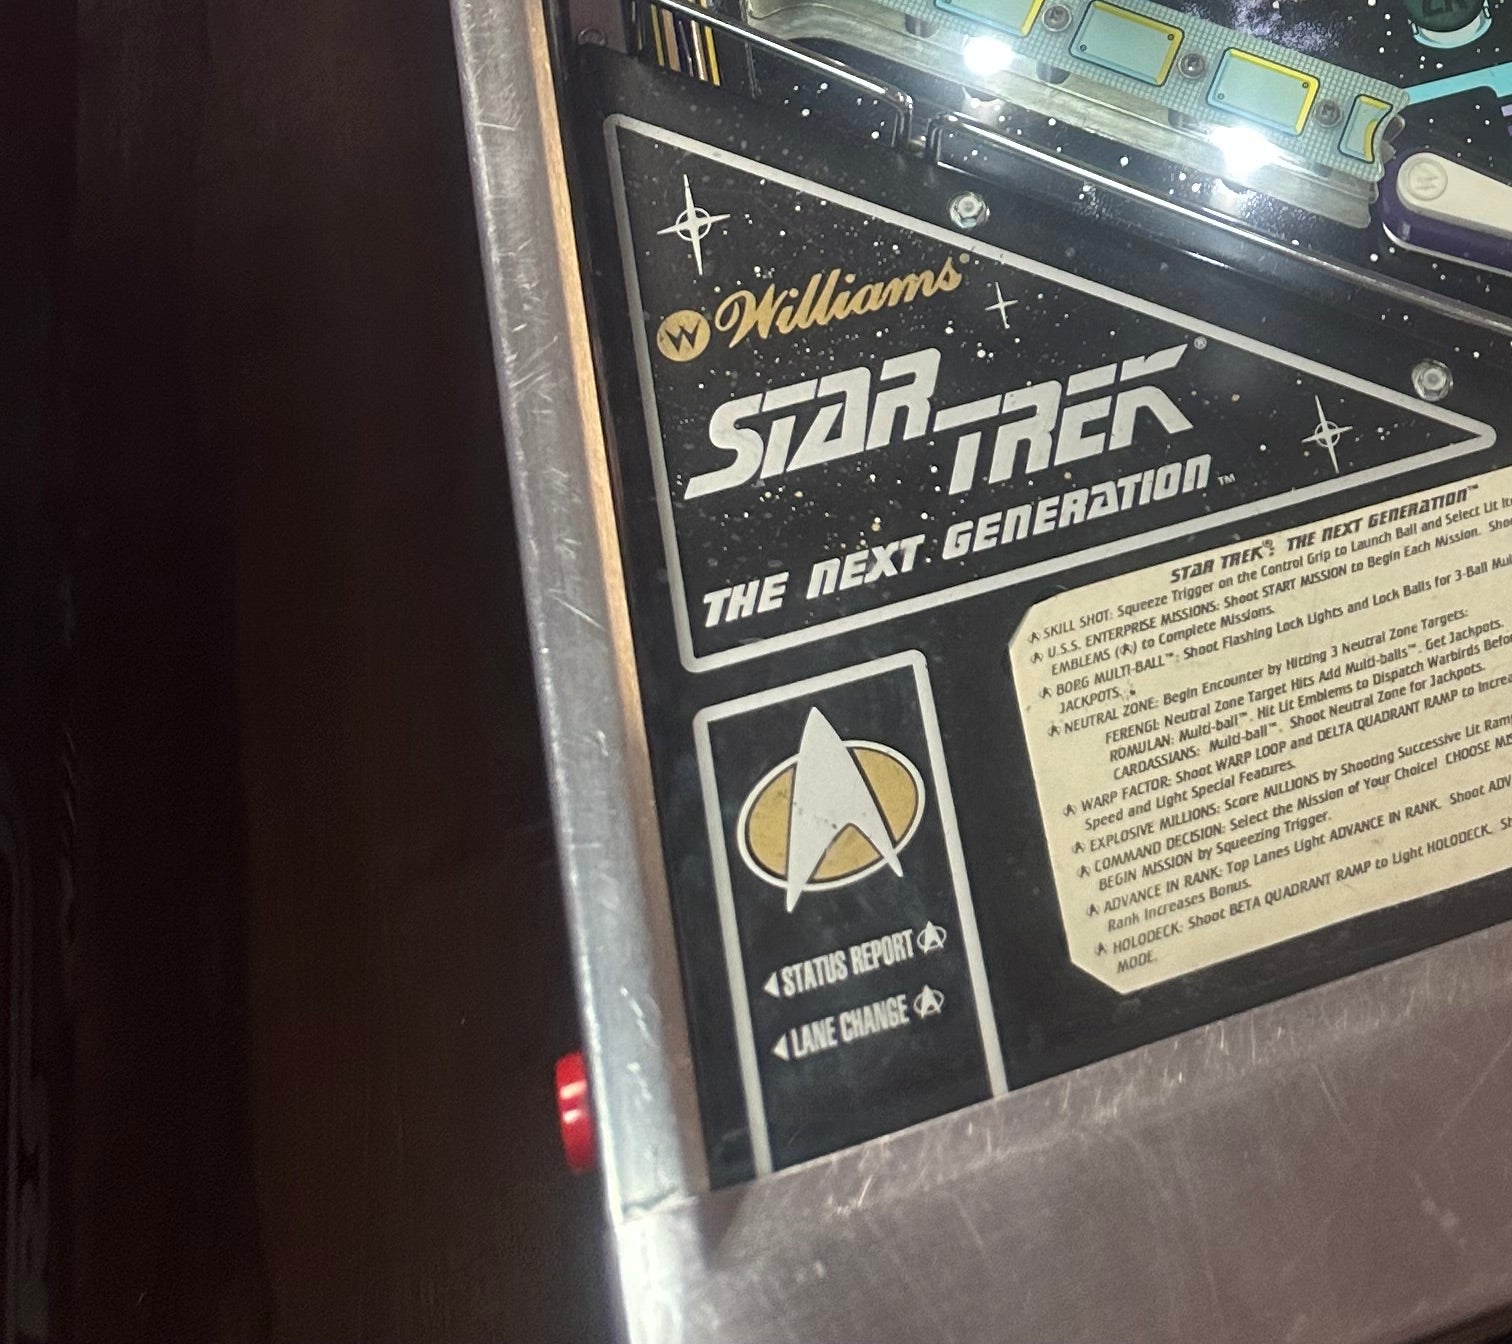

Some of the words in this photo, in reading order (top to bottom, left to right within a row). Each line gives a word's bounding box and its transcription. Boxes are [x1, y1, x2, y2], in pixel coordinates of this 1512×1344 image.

[715, 254, 964, 350] Williams
[684, 347, 943, 500] STAR
[936, 342, 1193, 495] TREK
[702, 571, 788, 628] THE
[806, 534, 928, 600] NEXT
[942, 454, 1210, 562] GENERATION
[1043, 618, 1077, 640] SKILL
[1080, 610, 1114, 630] SHOT:
[1117, 593, 1168, 620] Squeeze
[1172, 580, 1214, 605] Trigger
[1218, 576, 1235, 589] on
[1237, 566, 1258, 584] the
[1260, 557, 1305, 578] Control
[1306, 548, 1332, 569] Grip
[1334, 543, 1348, 559] to
[1351, 529, 1392, 552] Launch
[1395, 522, 1418, 540] Ball
[1420, 515, 1443, 533] and
[1445, 505, 1480, 526] Select
[1483, 500, 1500, 516] Lit
[1170, 559, 1214, 584] STAR
[1287, 529, 1316, 552] THE
[1322, 515, 1364, 542] NEXT
[781, 953, 846, 999] STATUS
[850, 929, 915, 975] REPORT
[791, 1021, 838, 1059] LANE
[840, 994, 909, 1043] CHANGE
